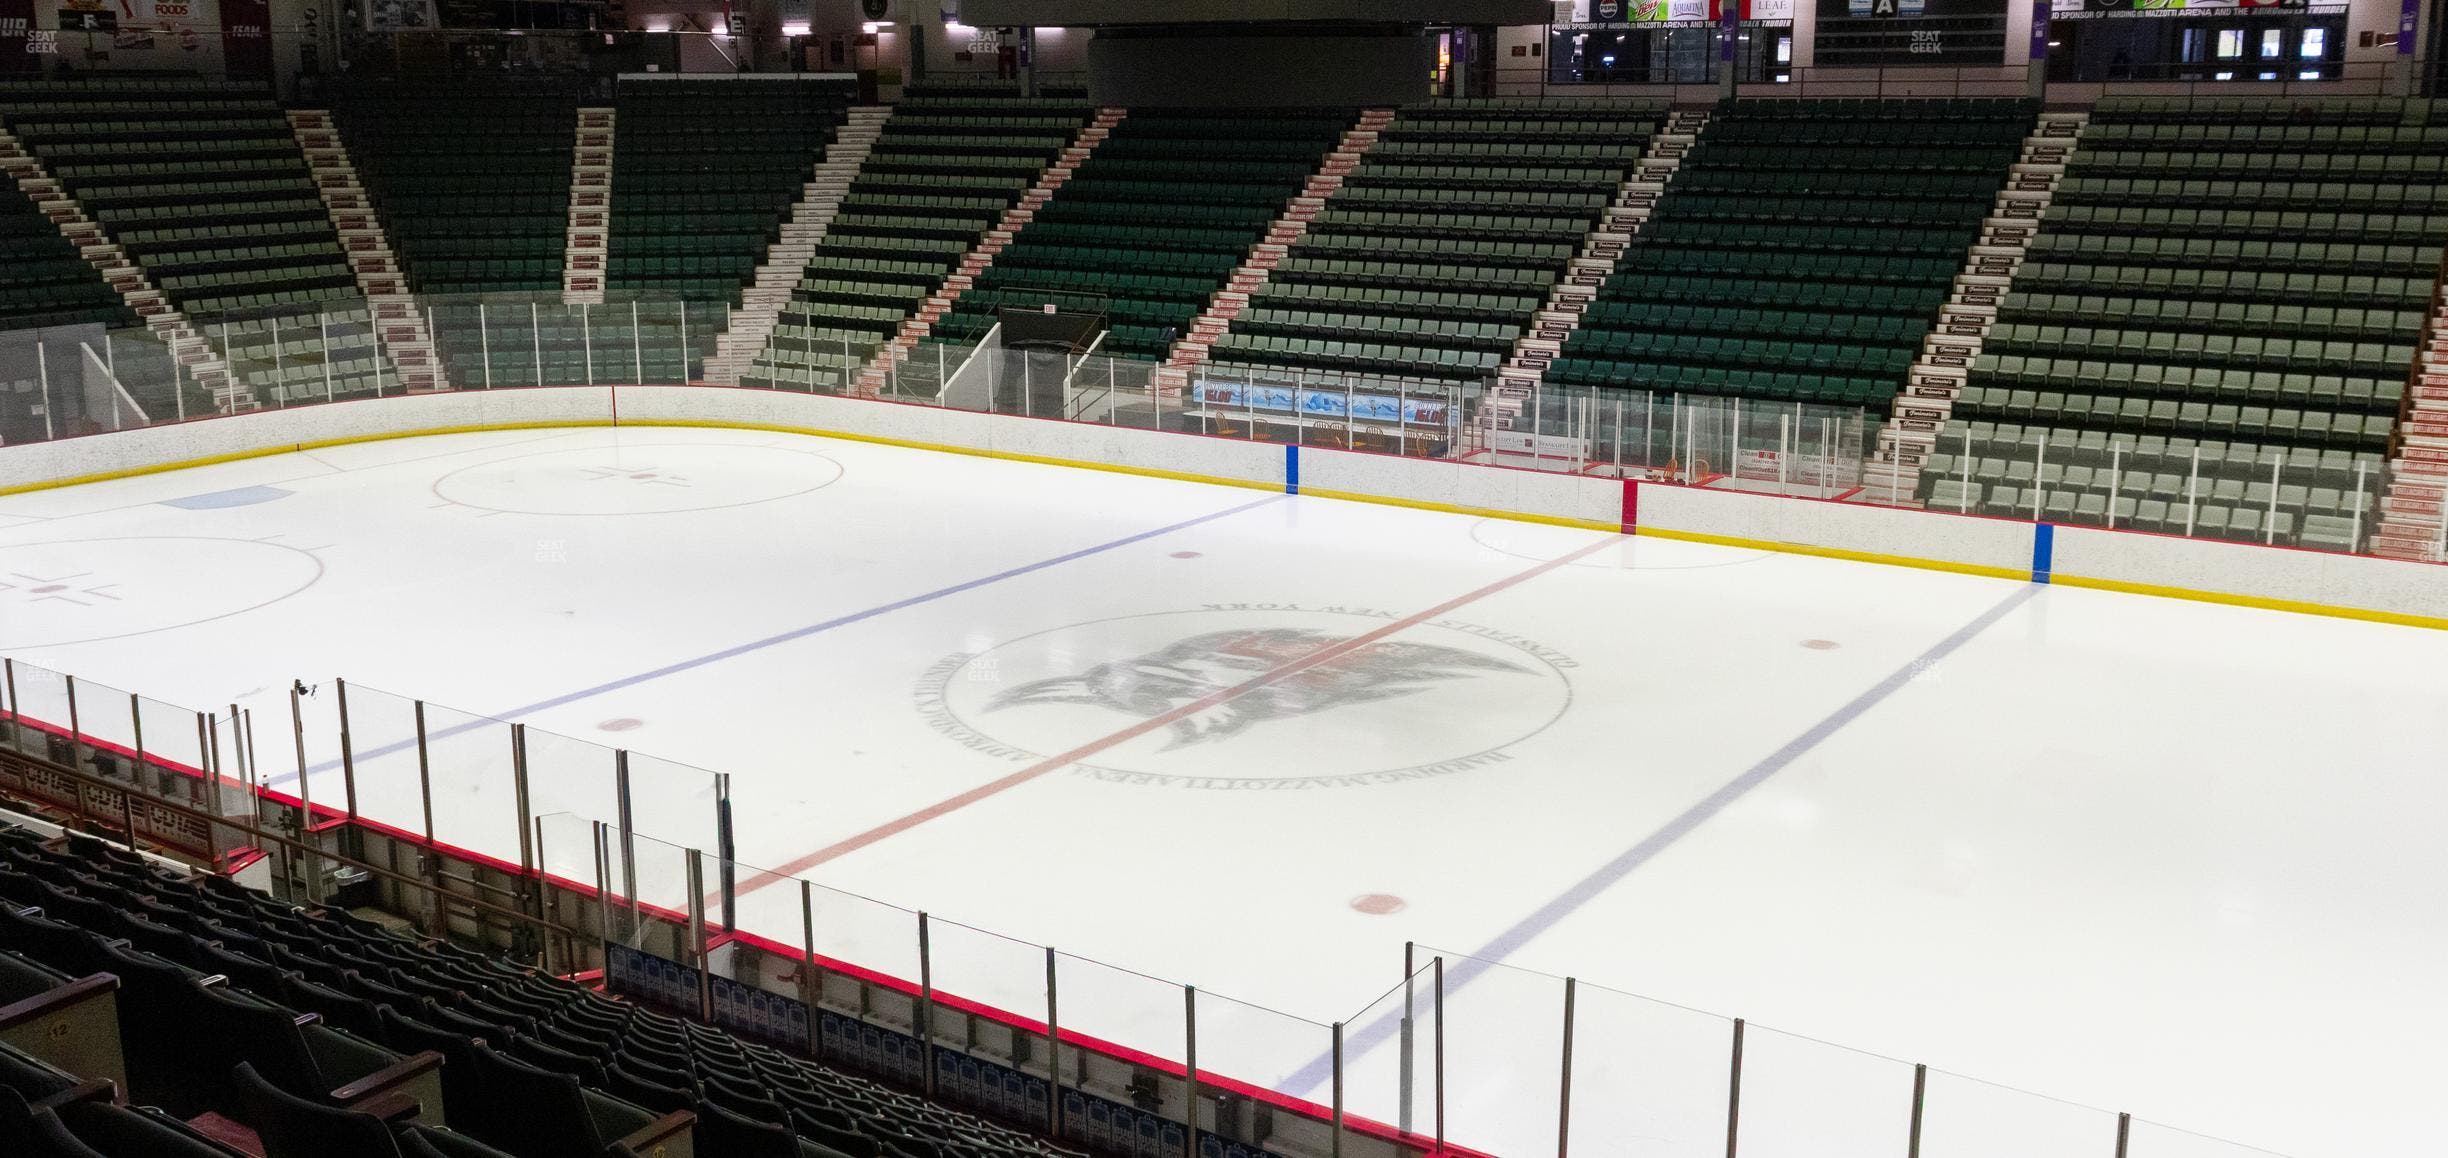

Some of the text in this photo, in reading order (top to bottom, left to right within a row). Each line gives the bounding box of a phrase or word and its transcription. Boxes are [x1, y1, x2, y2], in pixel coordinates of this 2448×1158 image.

[155, 5, 188, 15] FOODS
[2061, 11, 2094, 19] SPONSOR
[2178, 8, 2211, 16] ARENA
[2214, 8, 2231, 16] AND
[2234, 8, 2249, 16] THE
[1201, 602, 1301, 611] YORK
[1322, 605, 1398, 618] NEW
[1374, 751, 1515, 783] HARDING
[1185, 775, 1370, 790] MAZZOTTI
